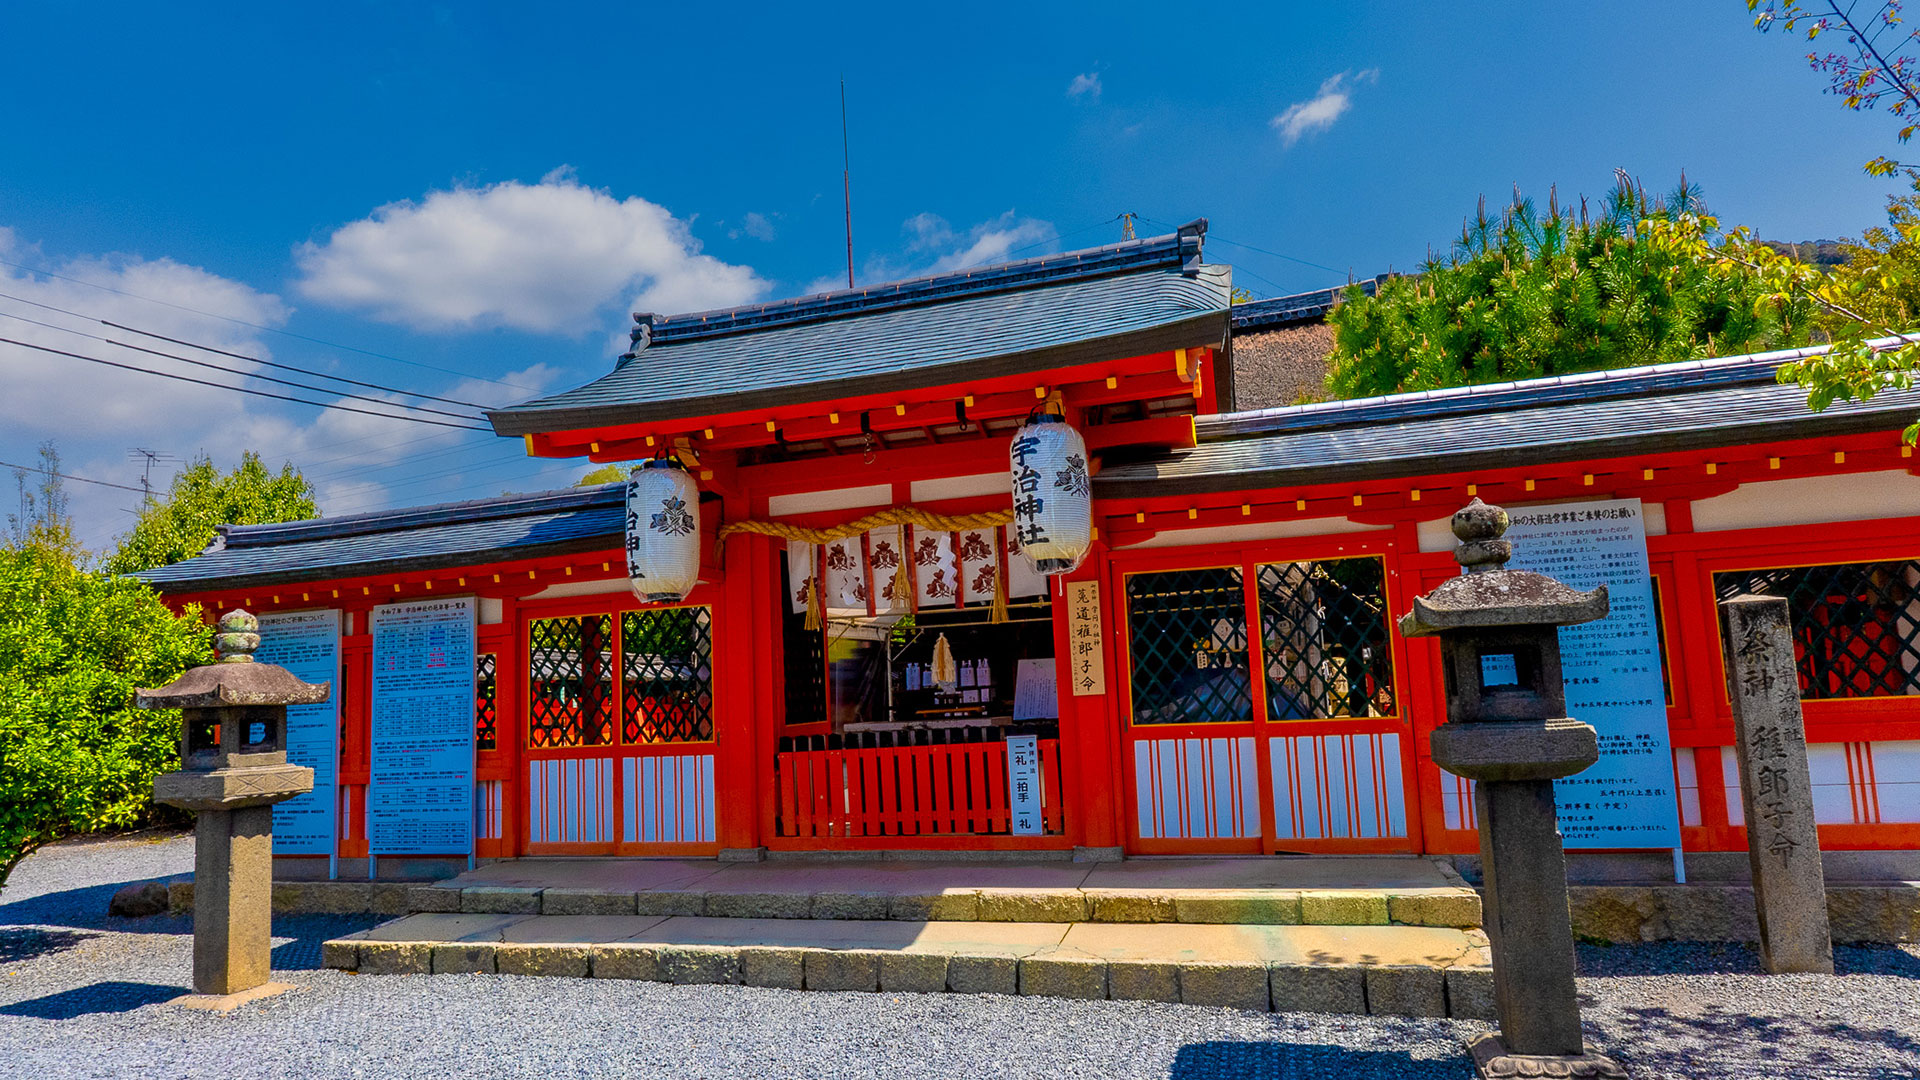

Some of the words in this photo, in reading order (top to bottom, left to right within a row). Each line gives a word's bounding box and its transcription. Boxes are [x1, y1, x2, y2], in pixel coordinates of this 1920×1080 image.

[1011, 435, 1049, 547] 宇治神社
[1015, 745, 1027, 765] 二礼
[1016, 772, 1029, 803] 二拍手
[1750, 725, 1801, 869] 稚郎子命
[1018, 811, 1031, 829] 一礼
